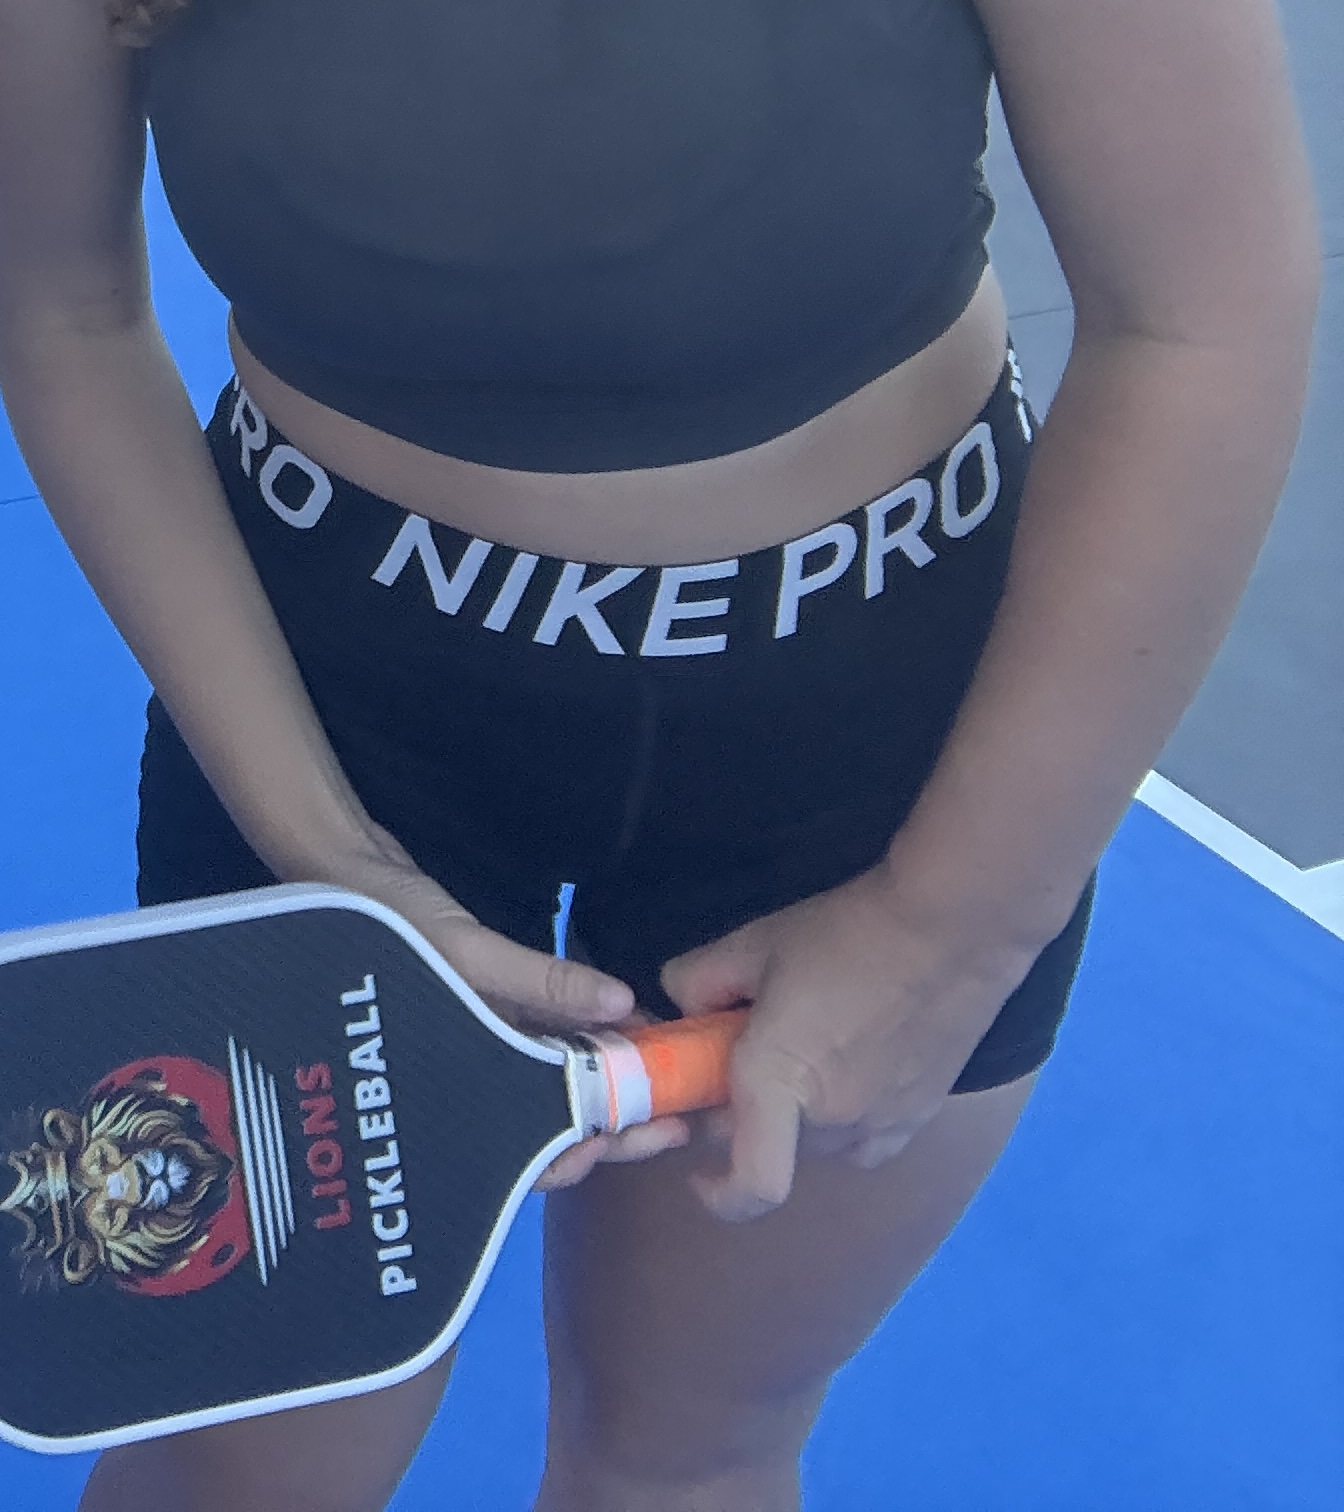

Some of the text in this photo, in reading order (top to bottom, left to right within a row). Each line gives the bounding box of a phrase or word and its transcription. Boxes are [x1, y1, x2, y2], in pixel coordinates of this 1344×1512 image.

[230, 374, 334, 530] RO
[371, 421, 1001, 658] NIKE PRO
[295, 1062, 352, 1230] LIONS
[339, 973, 418, 1297] PICKLEBALL
